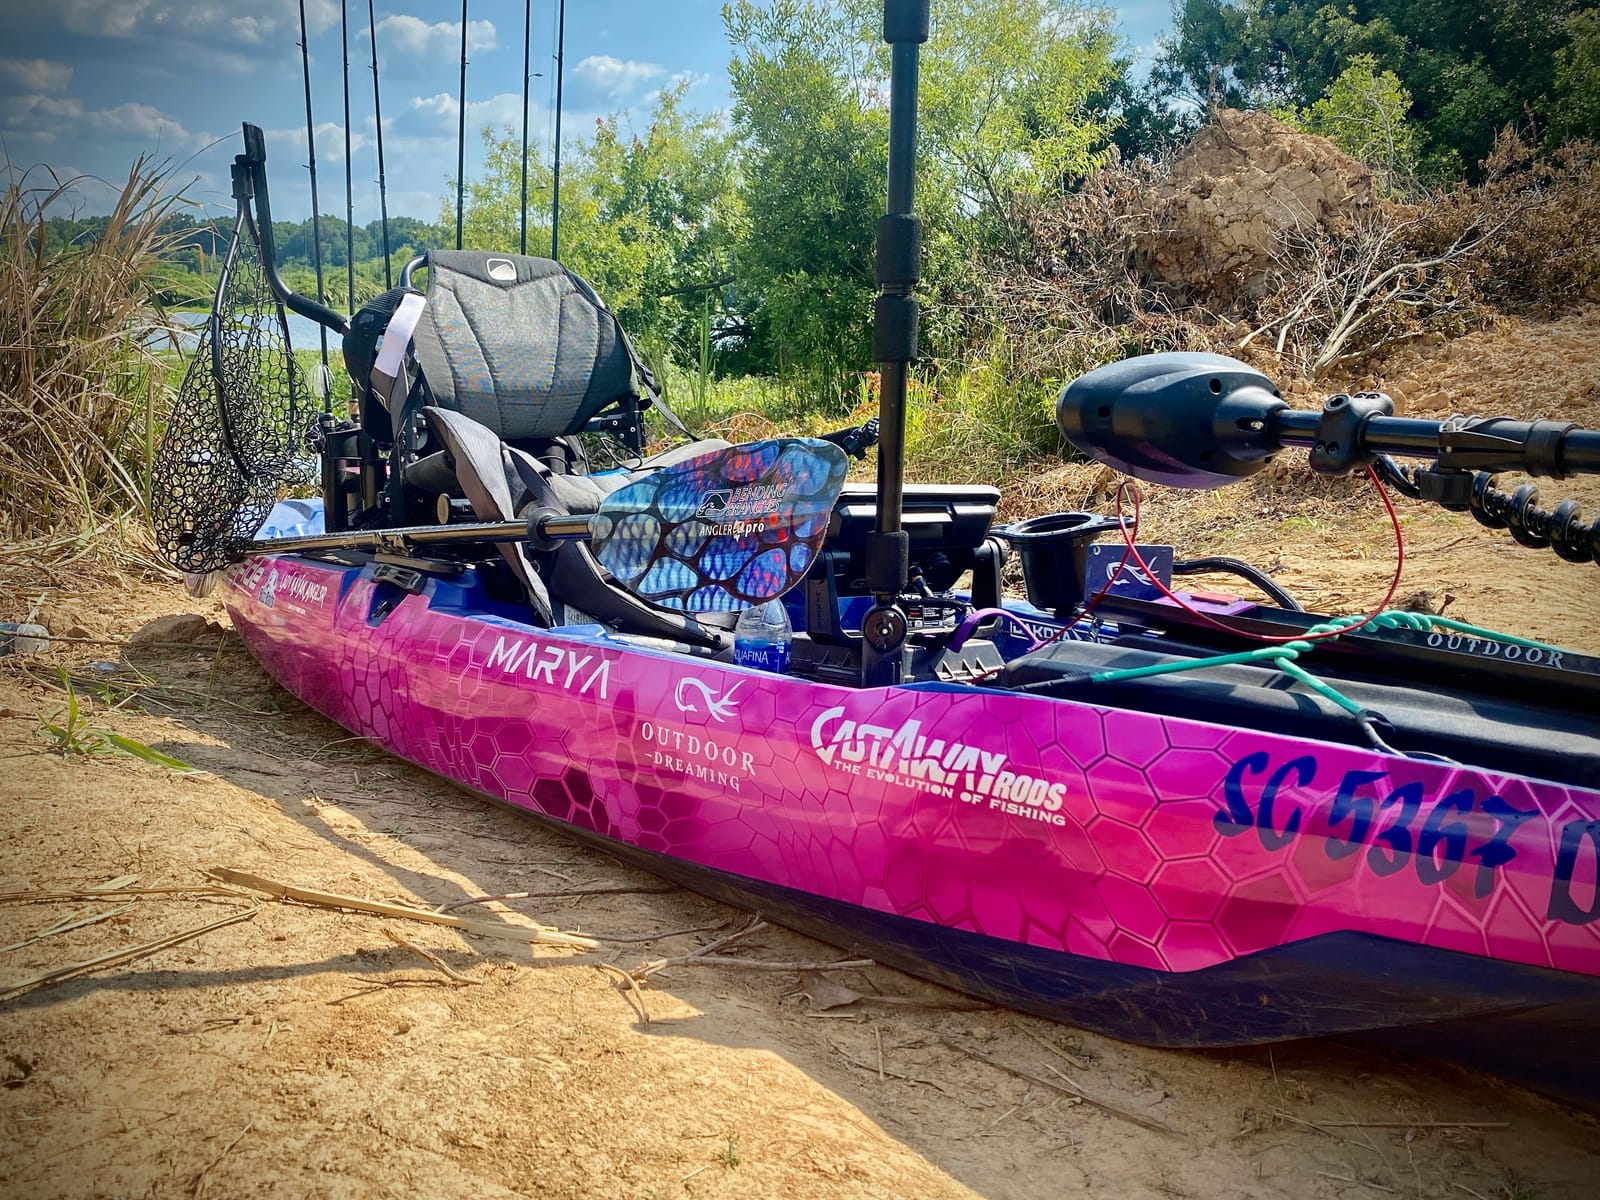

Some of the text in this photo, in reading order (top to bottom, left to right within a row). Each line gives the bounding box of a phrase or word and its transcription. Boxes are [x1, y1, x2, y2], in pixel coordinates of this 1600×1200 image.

[732, 483, 788, 502] BENDING
[699, 522, 765, 537] ANGLER pro
[486, 635, 611, 700] MARYA
[1426, 632, 1565, 669] OUTDOOR
[641, 721, 757, 777] OUTDOOR
[653, 752, 740, 794] DREAMING
[834, 758, 1066, 827] THE EVOLUTION OF FISHING
[992, 769, 1067, 812] RODS
[1212, 751, 1318, 852] SC
[1323, 769, 1541, 899] 5367
